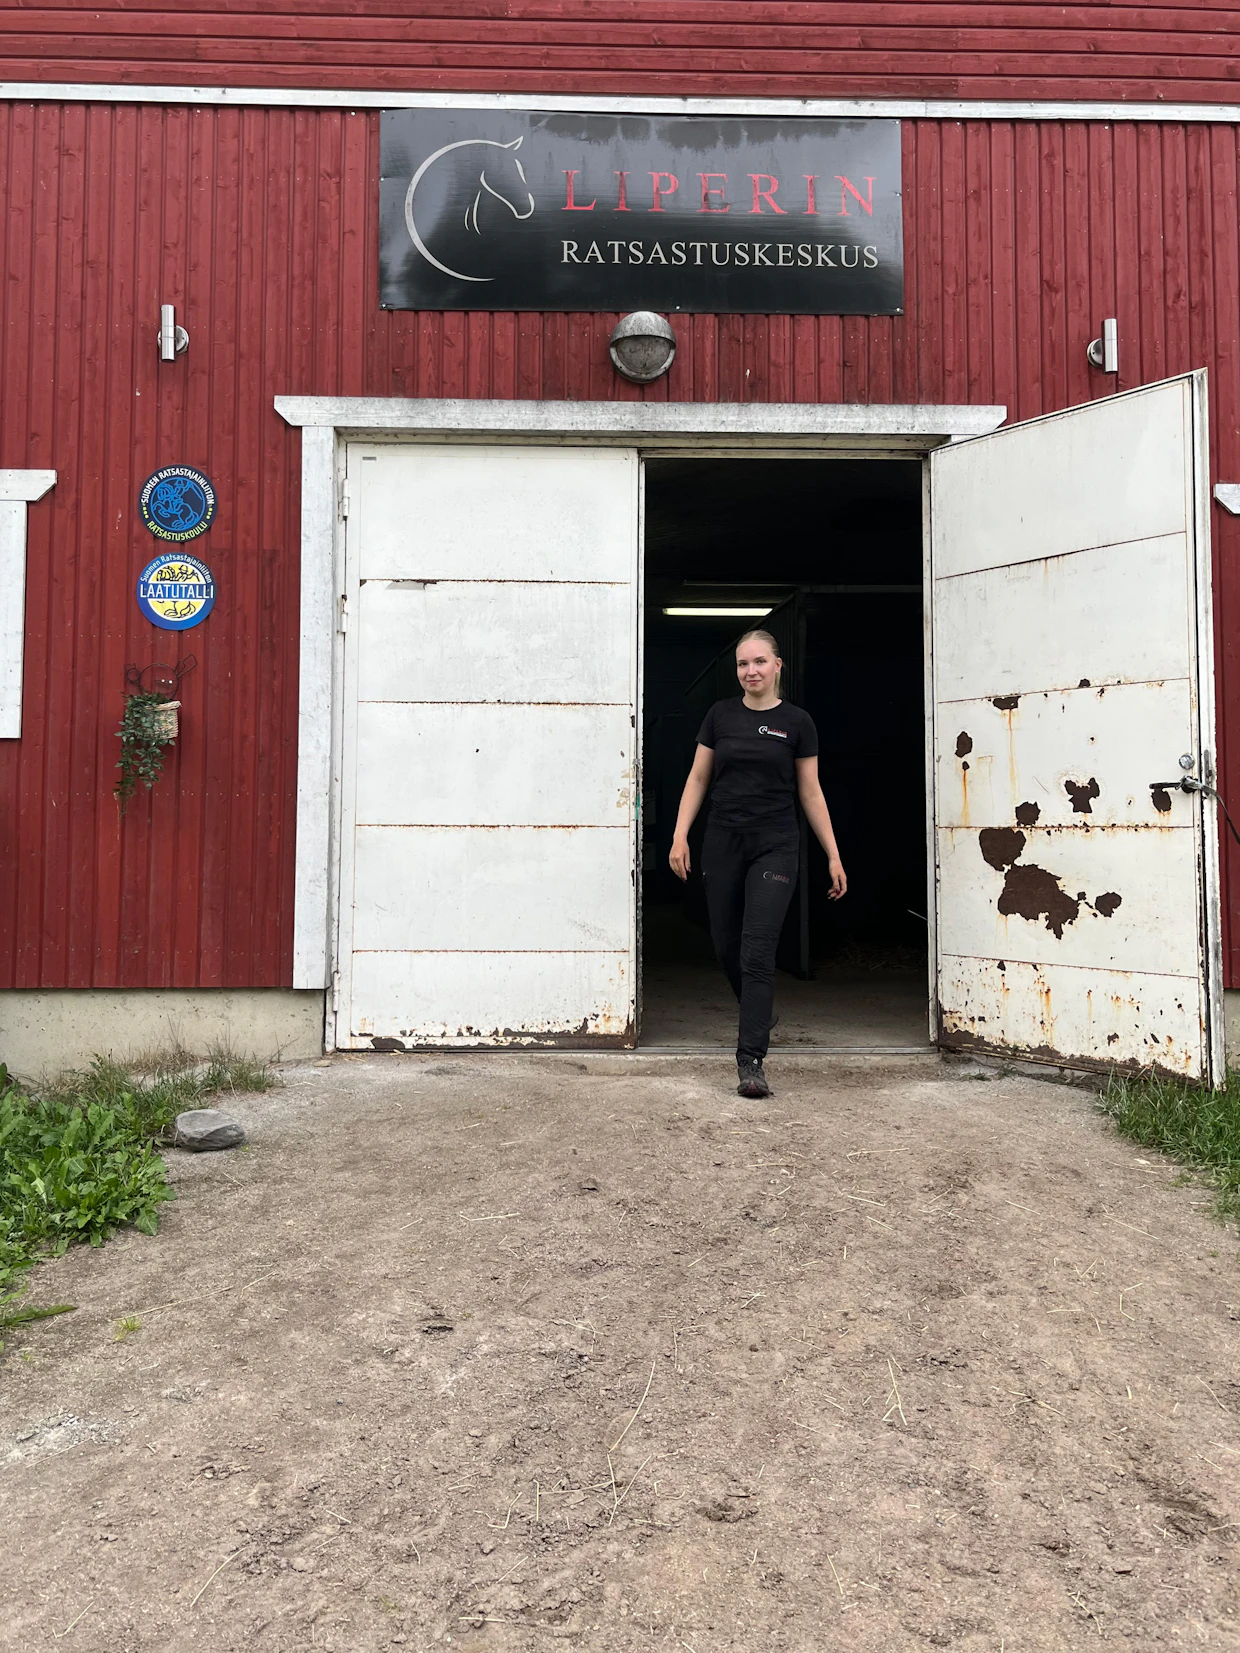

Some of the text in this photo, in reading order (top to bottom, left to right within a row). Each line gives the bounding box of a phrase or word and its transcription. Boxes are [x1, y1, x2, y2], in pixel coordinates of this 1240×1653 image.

[561, 169, 877, 217] LIPERIN
[561, 239, 879, 269] RATSASTUSKESKUS
[141, 467, 215, 505] SUOMEN RATSASTAJAINLIITON
[147, 521, 208, 541] RATSASTUSKOULU
[141, 553, 213, 584] Suomen Ratsastajainliiton
[140, 584, 214, 599] LAATUTALLI
